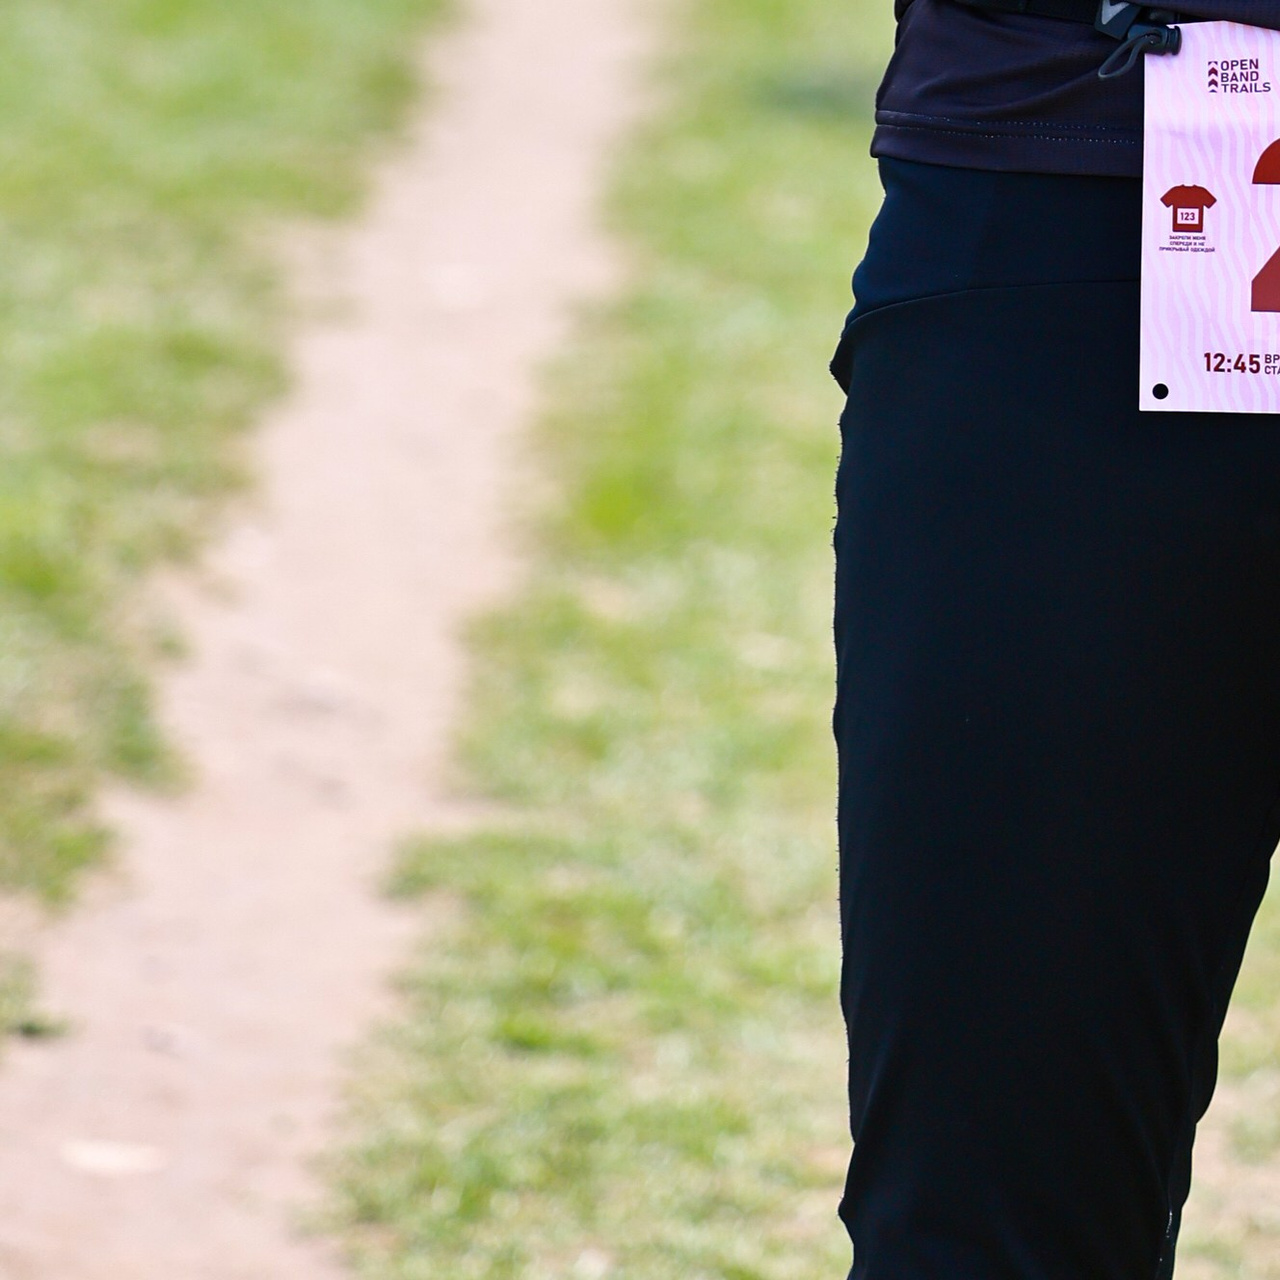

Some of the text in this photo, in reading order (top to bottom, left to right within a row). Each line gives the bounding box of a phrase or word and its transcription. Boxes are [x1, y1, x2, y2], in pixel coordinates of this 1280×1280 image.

[1221, 58, 1259, 71] OPEN
[1221, 71, 1259, 82] BAND
[1221, 82, 1271, 93] TRAILS
[1180, 212, 1195, 221] 123
[1204, 352, 1260, 374] 12:45
